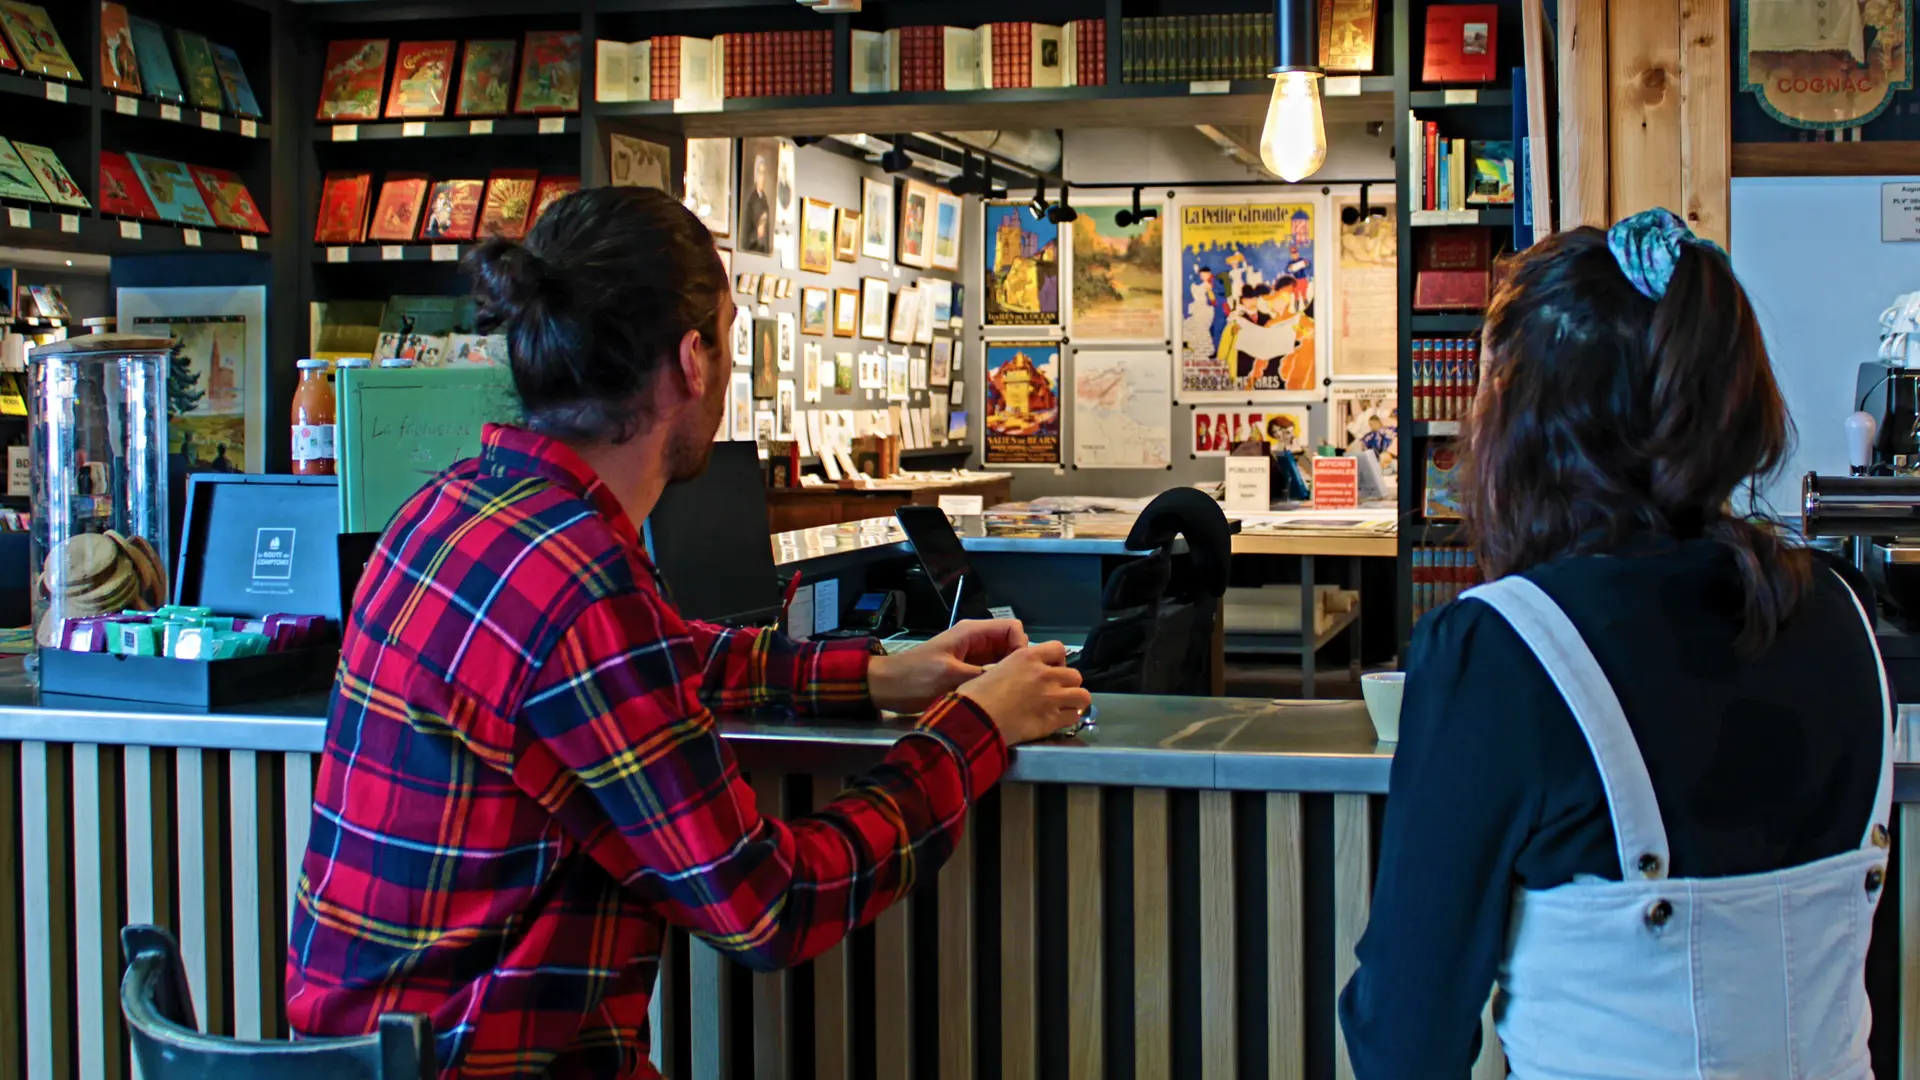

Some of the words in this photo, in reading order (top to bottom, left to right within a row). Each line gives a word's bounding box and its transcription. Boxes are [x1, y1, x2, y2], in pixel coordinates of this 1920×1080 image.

[1777, 77, 1872, 94] COGNAC
[1185, 207, 1199, 224] La
[1202, 206, 1236, 223] Petite
[1238, 205, 1289, 222] Gironde
